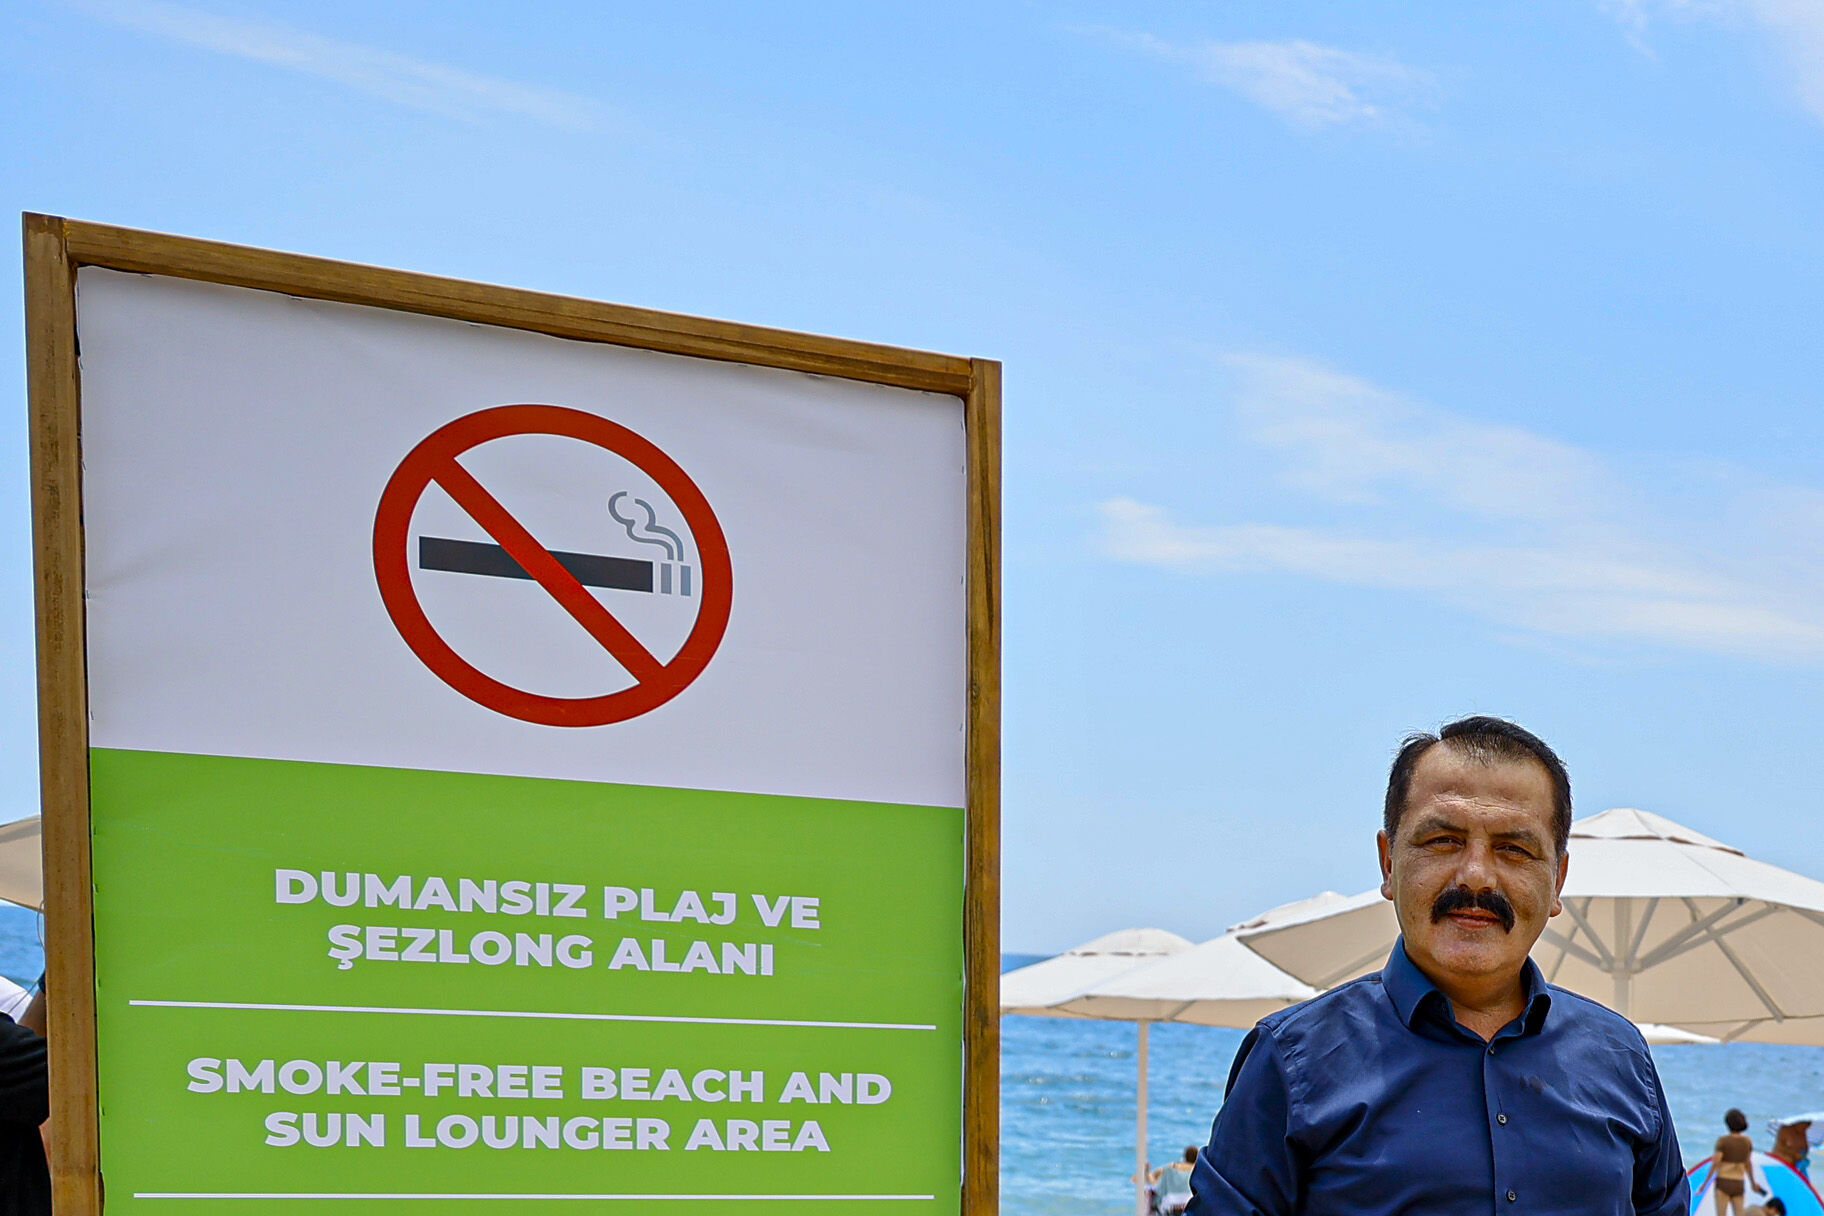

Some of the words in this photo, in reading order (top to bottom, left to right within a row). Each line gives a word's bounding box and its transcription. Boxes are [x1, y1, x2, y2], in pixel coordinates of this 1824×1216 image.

[274, 868, 587, 918] DUMANSIZ
[602, 886, 738, 926] PLAJ
[750, 894, 822, 930] VE
[326, 924, 594, 971] ŞEZLONG
[607, 937, 775, 977] ALANI
[186, 1057, 565, 1100] SMOKE-FREE
[580, 1067, 765, 1104] BEACH
[778, 1071, 893, 1106] AND
[263, 1111, 386, 1149] SUN
[403, 1114, 672, 1152] LOUNGER
[684, 1119, 832, 1153] AREA
